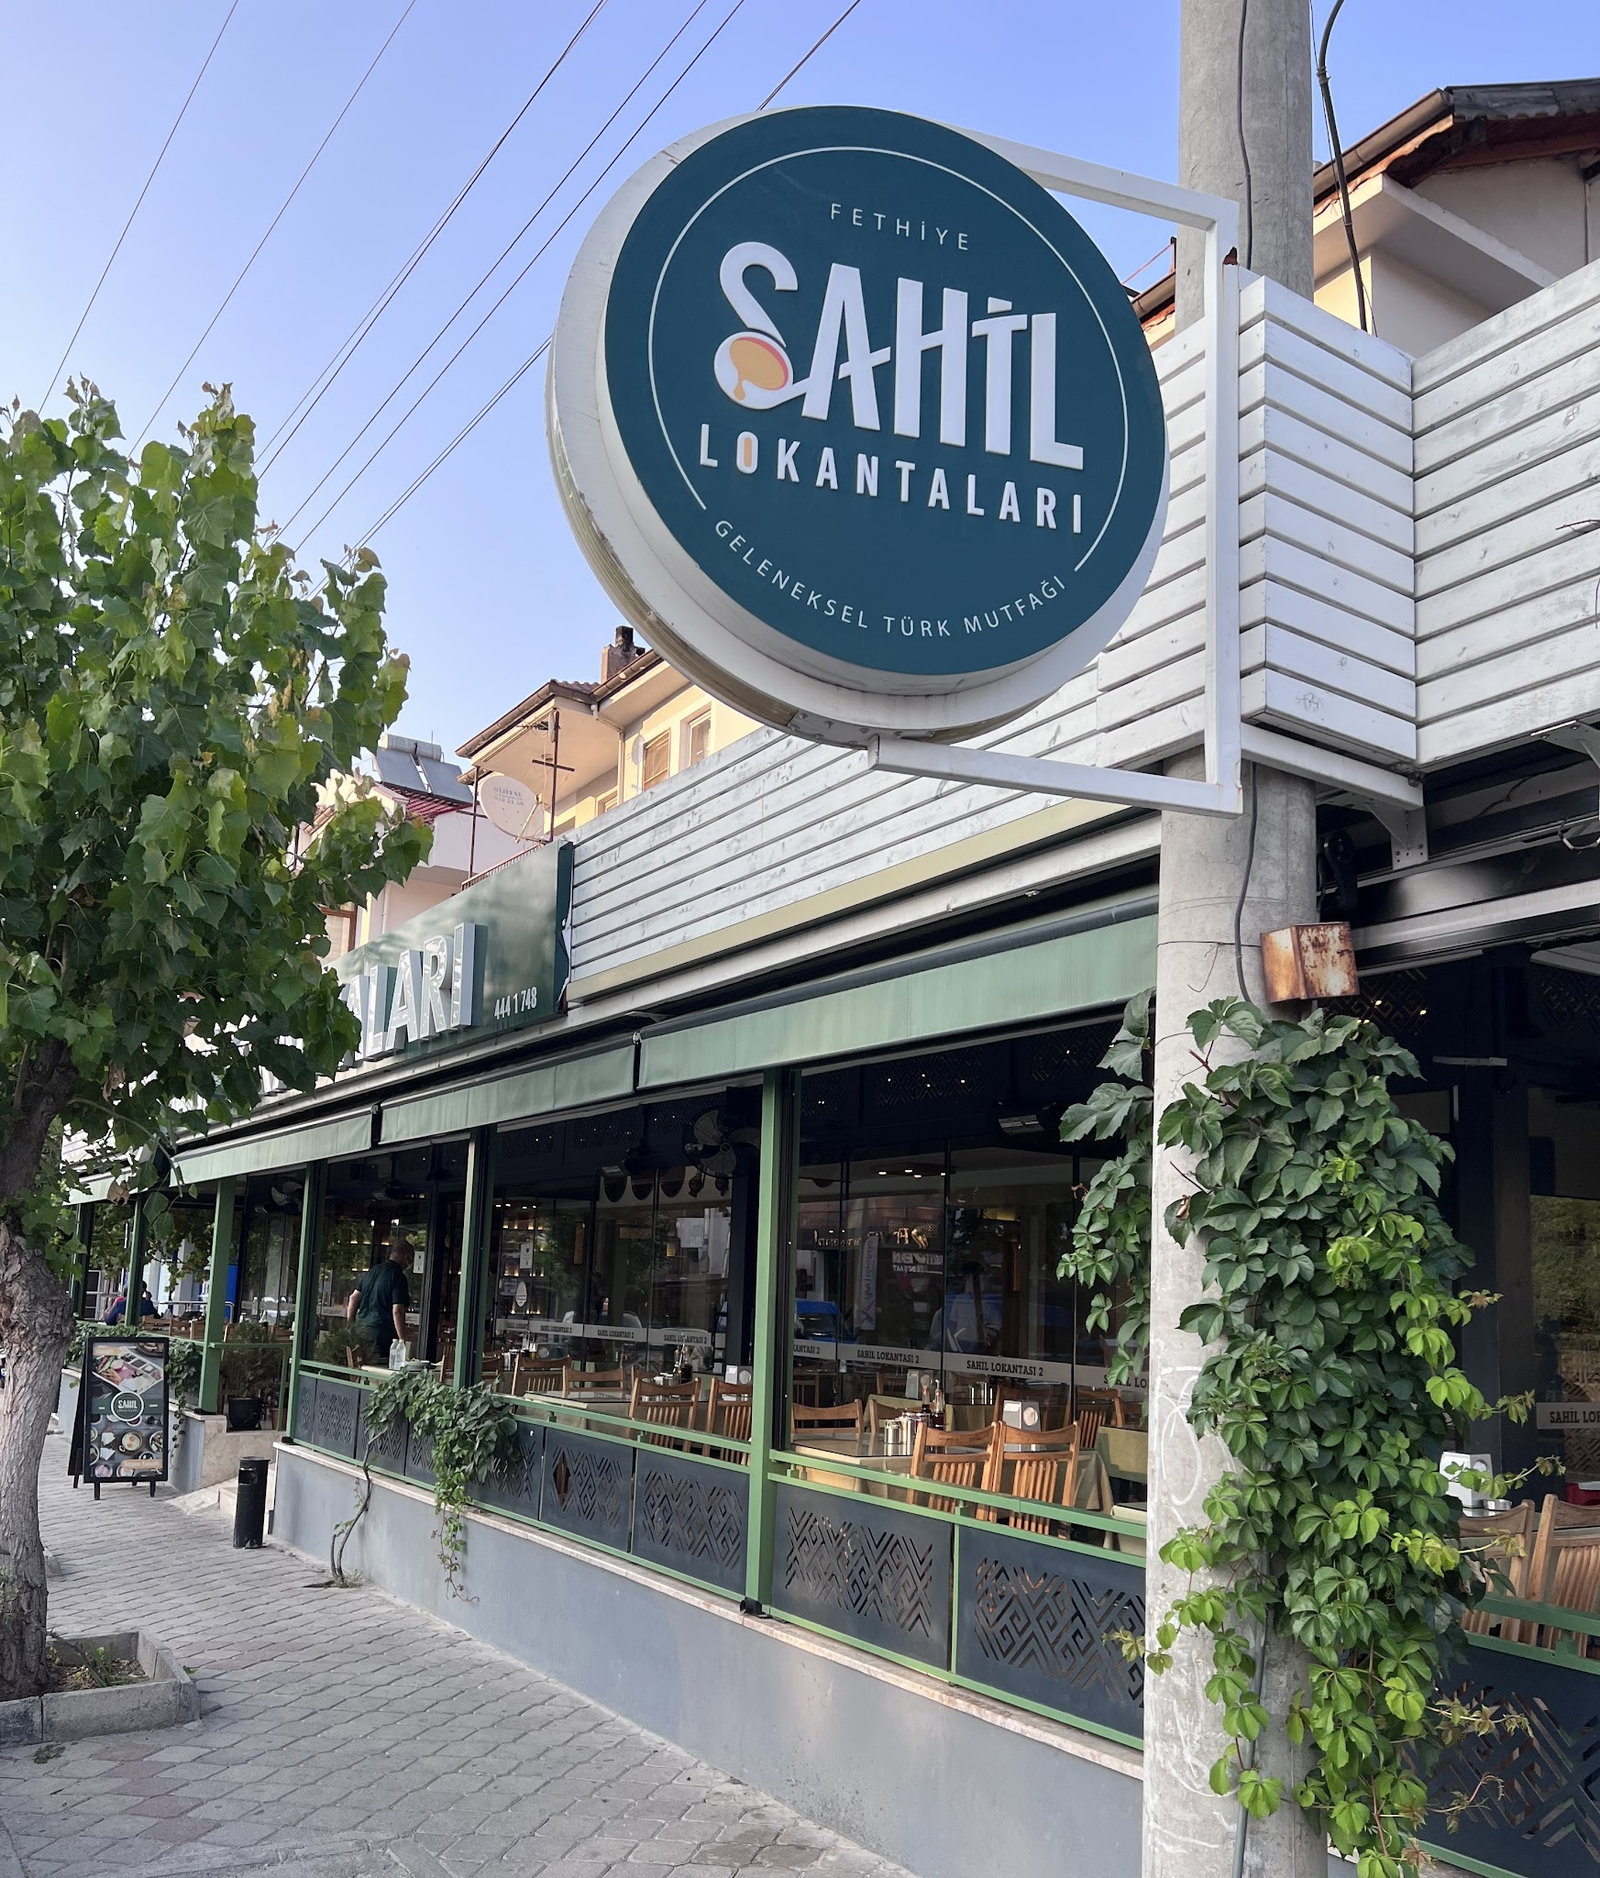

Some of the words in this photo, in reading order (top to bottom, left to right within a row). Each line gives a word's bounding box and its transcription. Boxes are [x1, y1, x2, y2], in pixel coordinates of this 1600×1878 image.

[830, 202, 970, 252] FETHİYE
[713, 240, 1085, 471] SAHİL
[699, 422, 1083, 534] LOKANTALARI
[714, 519, 870, 630] GELENEKSEL
[883, 615, 951, 638] TÜRK
[964, 574, 1067, 633] MUTFAĞI
[494, 995, 511, 1020] 444
[512, 992, 518, 1014] 1
[520, 986, 538, 1012] 748
[876, 1351, 914, 1363] LOKANTASI
[915, 1355, 920, 1364] 2
[991, 1362, 1036, 1376] LOKANTASI
[1038, 1366, 1044, 1377] 2
